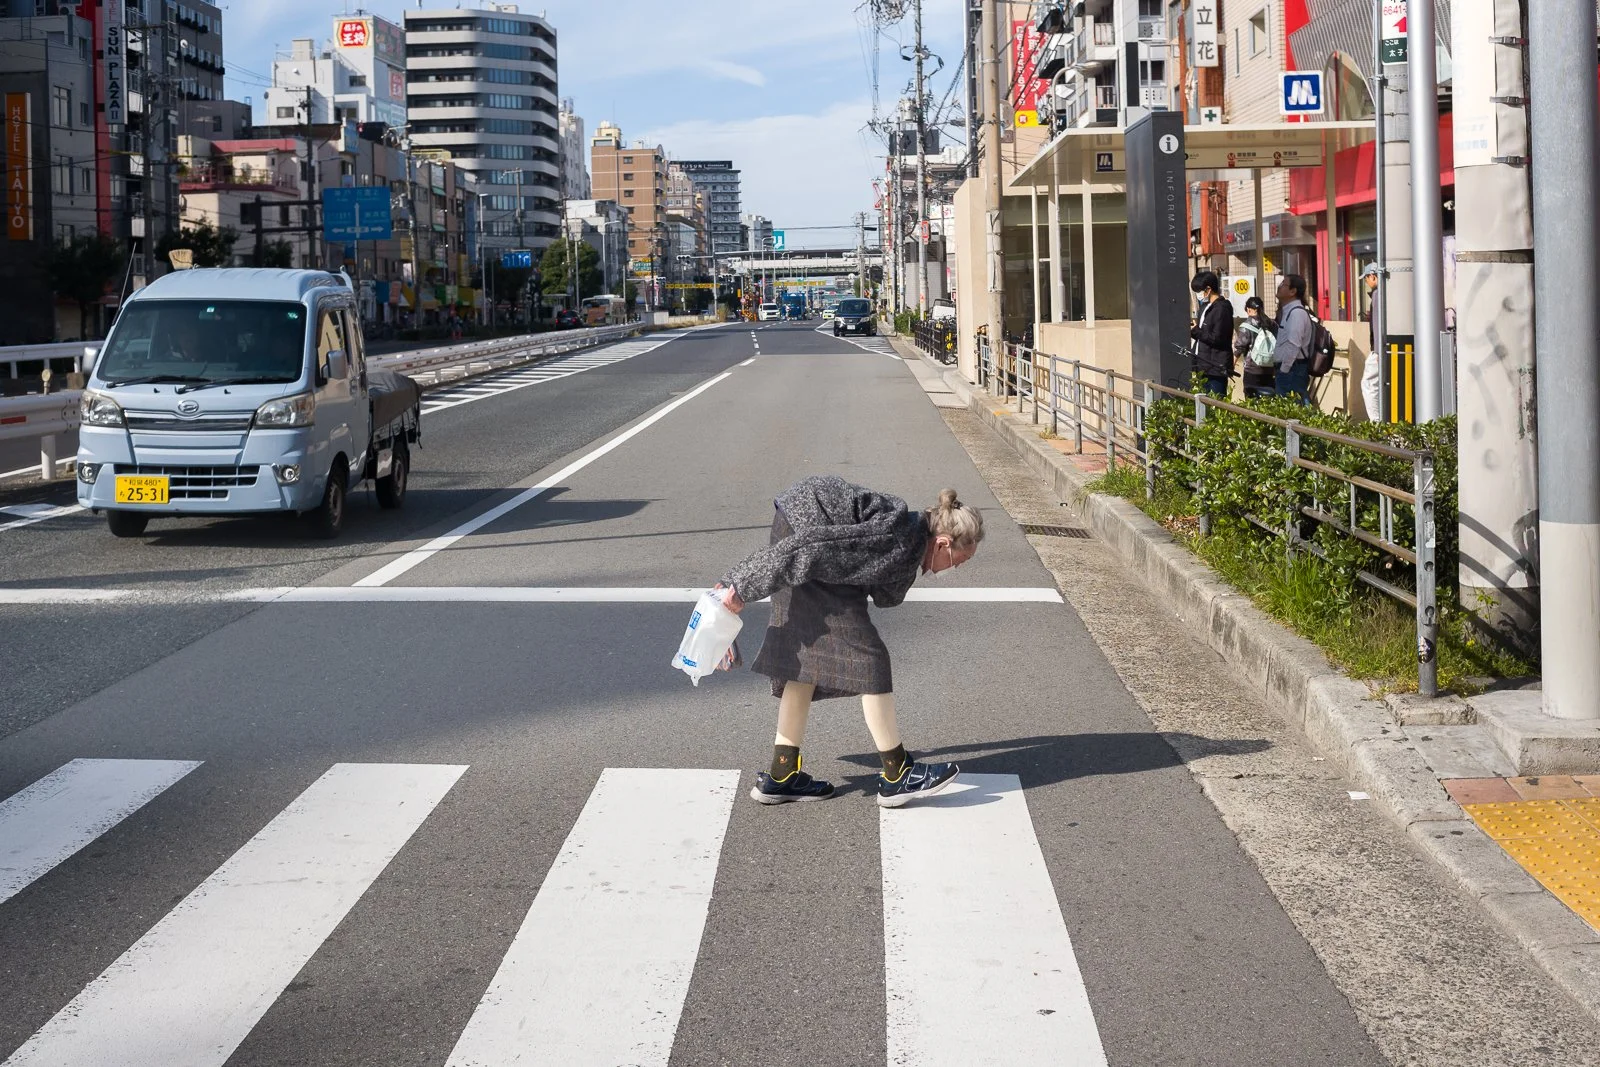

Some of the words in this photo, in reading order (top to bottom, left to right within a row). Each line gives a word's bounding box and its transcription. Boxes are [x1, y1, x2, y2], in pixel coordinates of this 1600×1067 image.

[1383, 5, 1407, 15] 6641-
[108, 26, 119, 56] SUN
[343, 33, 365, 45] 王将
[1389, 48, 1408, 57] 太子
[108, 62, 120, 109] PLAZA
[12, 106, 21, 152] HOTEL
[12, 165, 24, 228] TAIYO
[1166, 170, 1176, 264] INFORMATION
[1236, 282, 1249, 291] 100
[127, 487, 164, 501] 25-31
